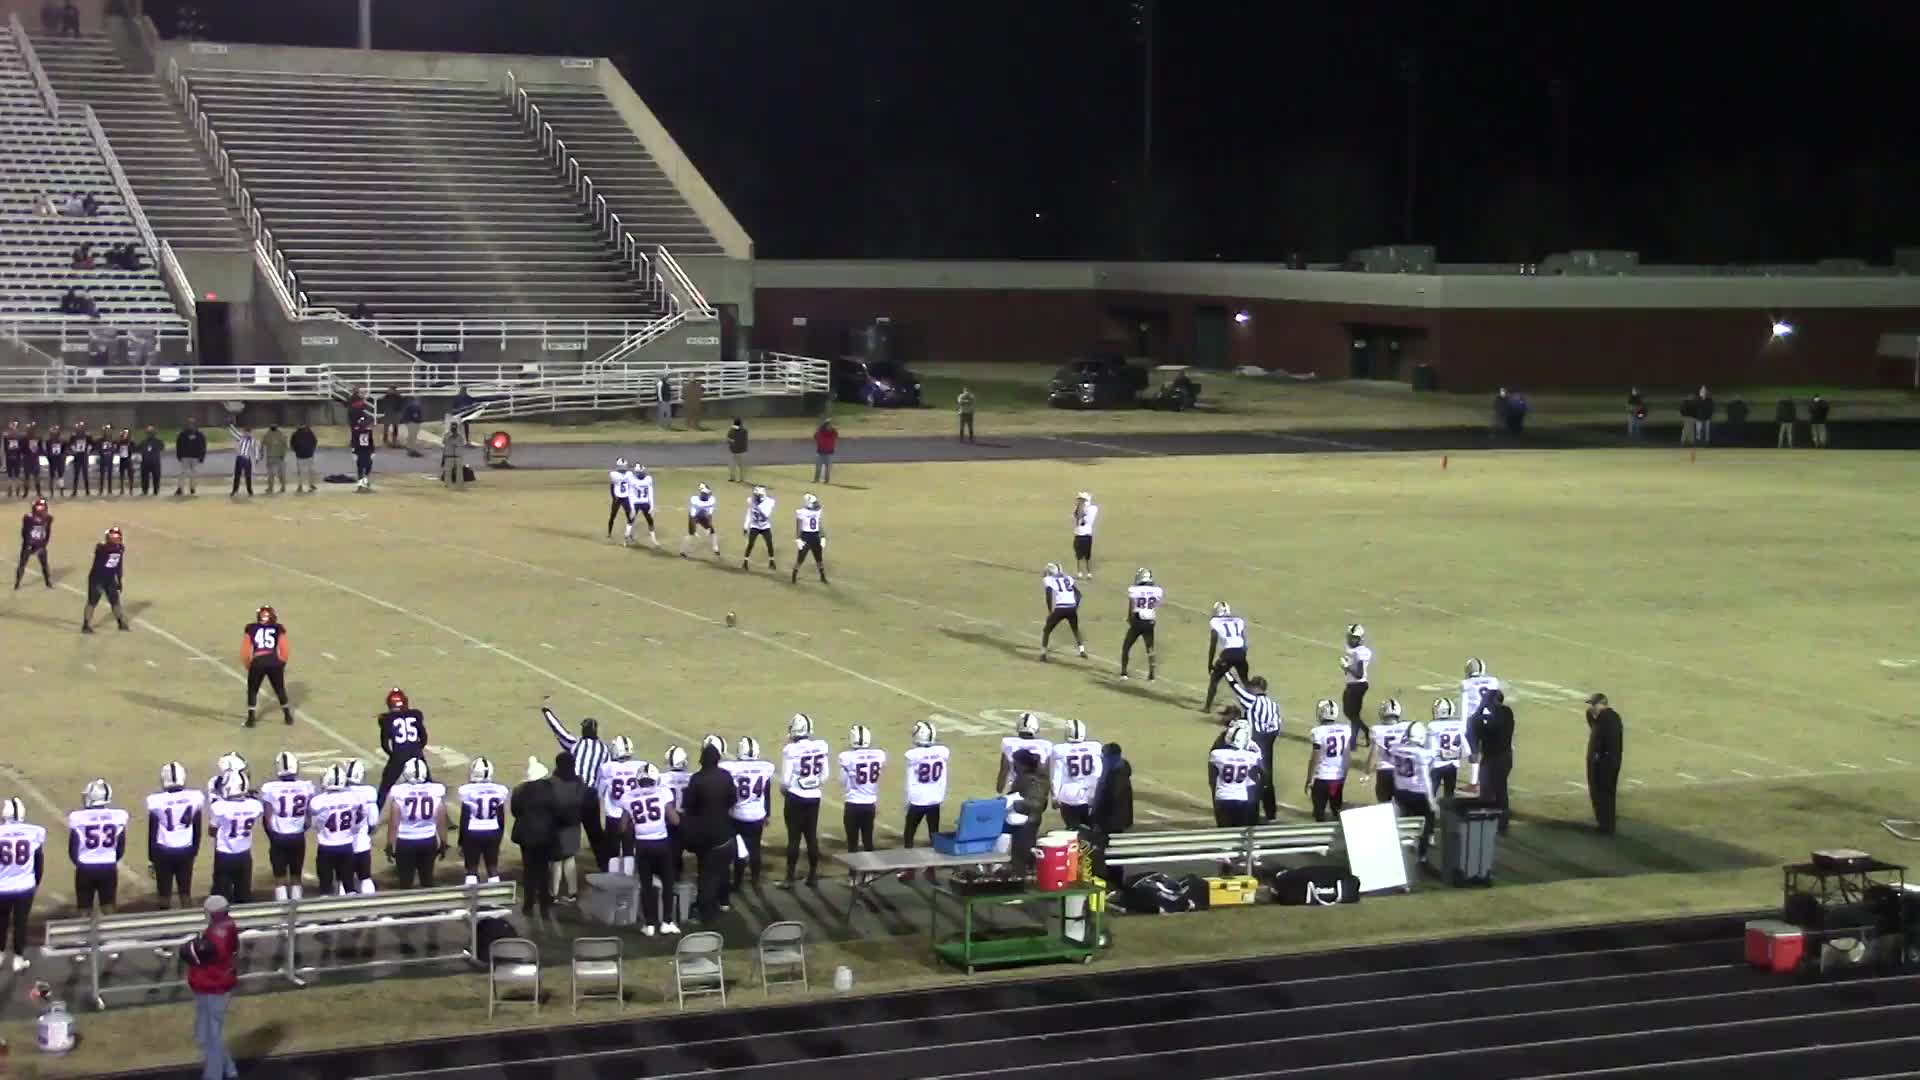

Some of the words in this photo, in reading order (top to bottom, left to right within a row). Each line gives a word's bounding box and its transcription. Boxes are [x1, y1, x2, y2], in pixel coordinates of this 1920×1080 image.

[255, 623, 275, 649] 45
[1223, 622, 1239, 637] 11
[394, 717, 419, 744] 35
[1326, 735, 1345, 758] 21
[738, 776, 763, 800] 64
[165, 805, 194, 831] 14
[405, 797, 434, 822] 70
[631, 797, 661, 824] 25
[85, 824, 117, 848] 53
[0, 839, 30, 866] 68
